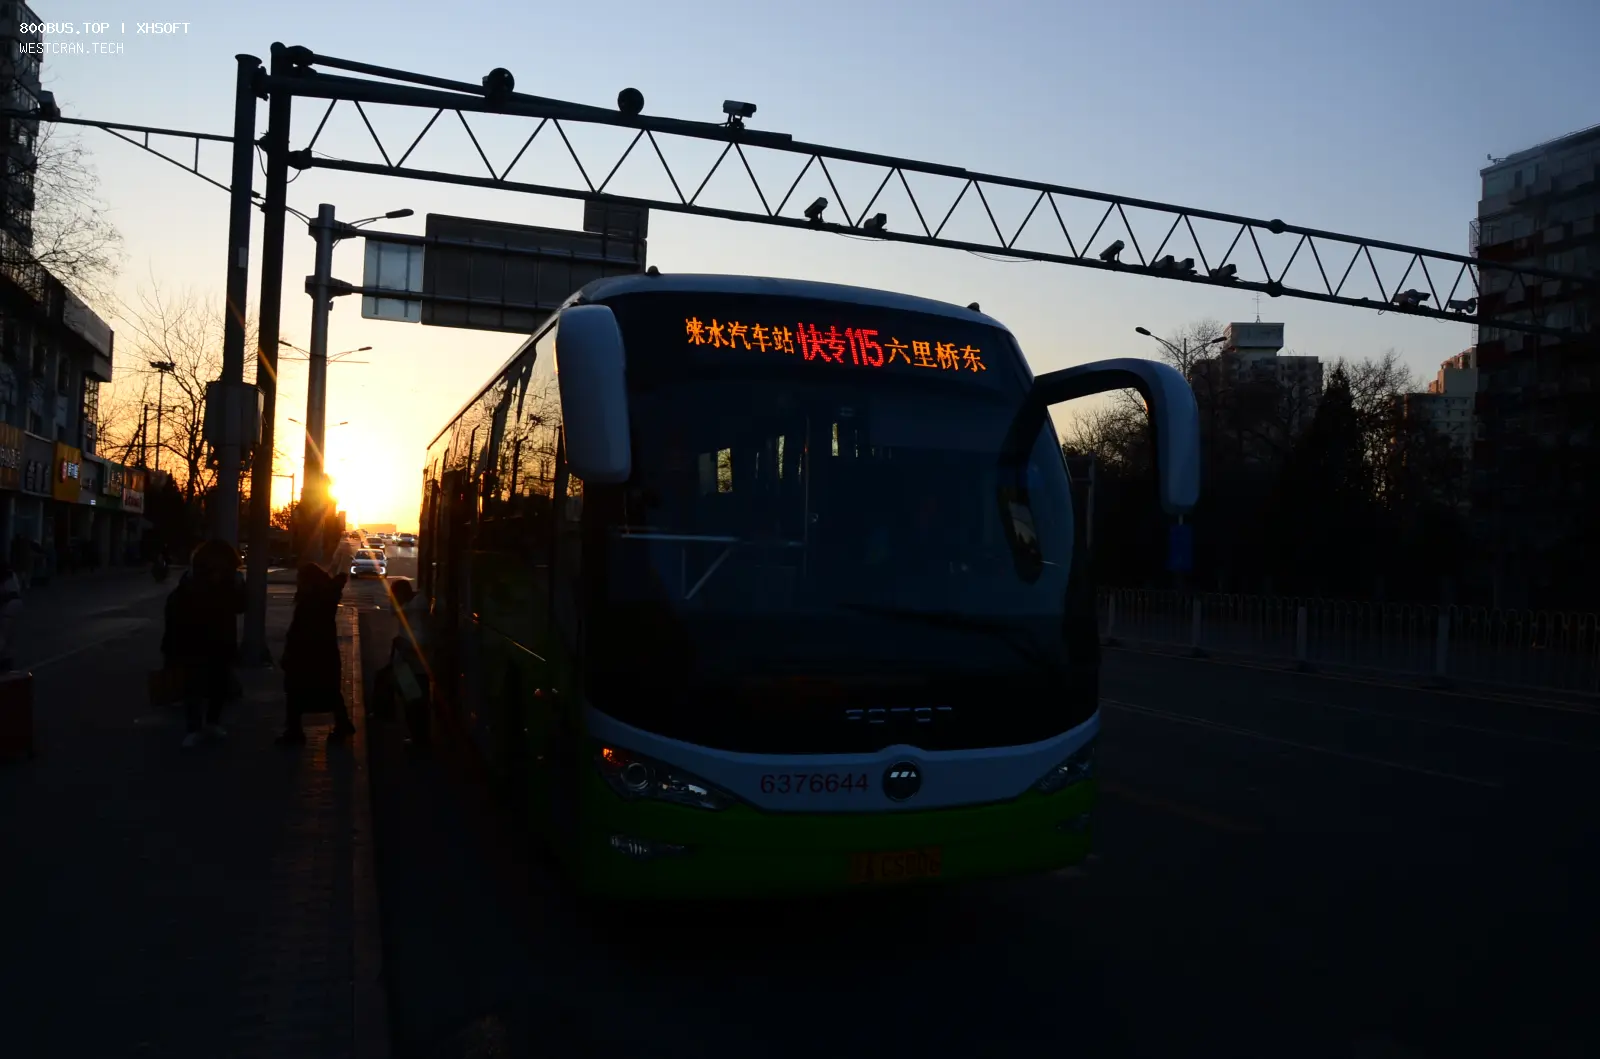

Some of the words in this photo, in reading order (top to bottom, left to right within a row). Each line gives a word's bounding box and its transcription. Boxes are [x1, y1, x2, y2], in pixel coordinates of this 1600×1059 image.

[796, 322, 884, 367] 快专115
[885, 336, 988, 373] 六里桥东
[760, 773, 869, 794] 6376644
